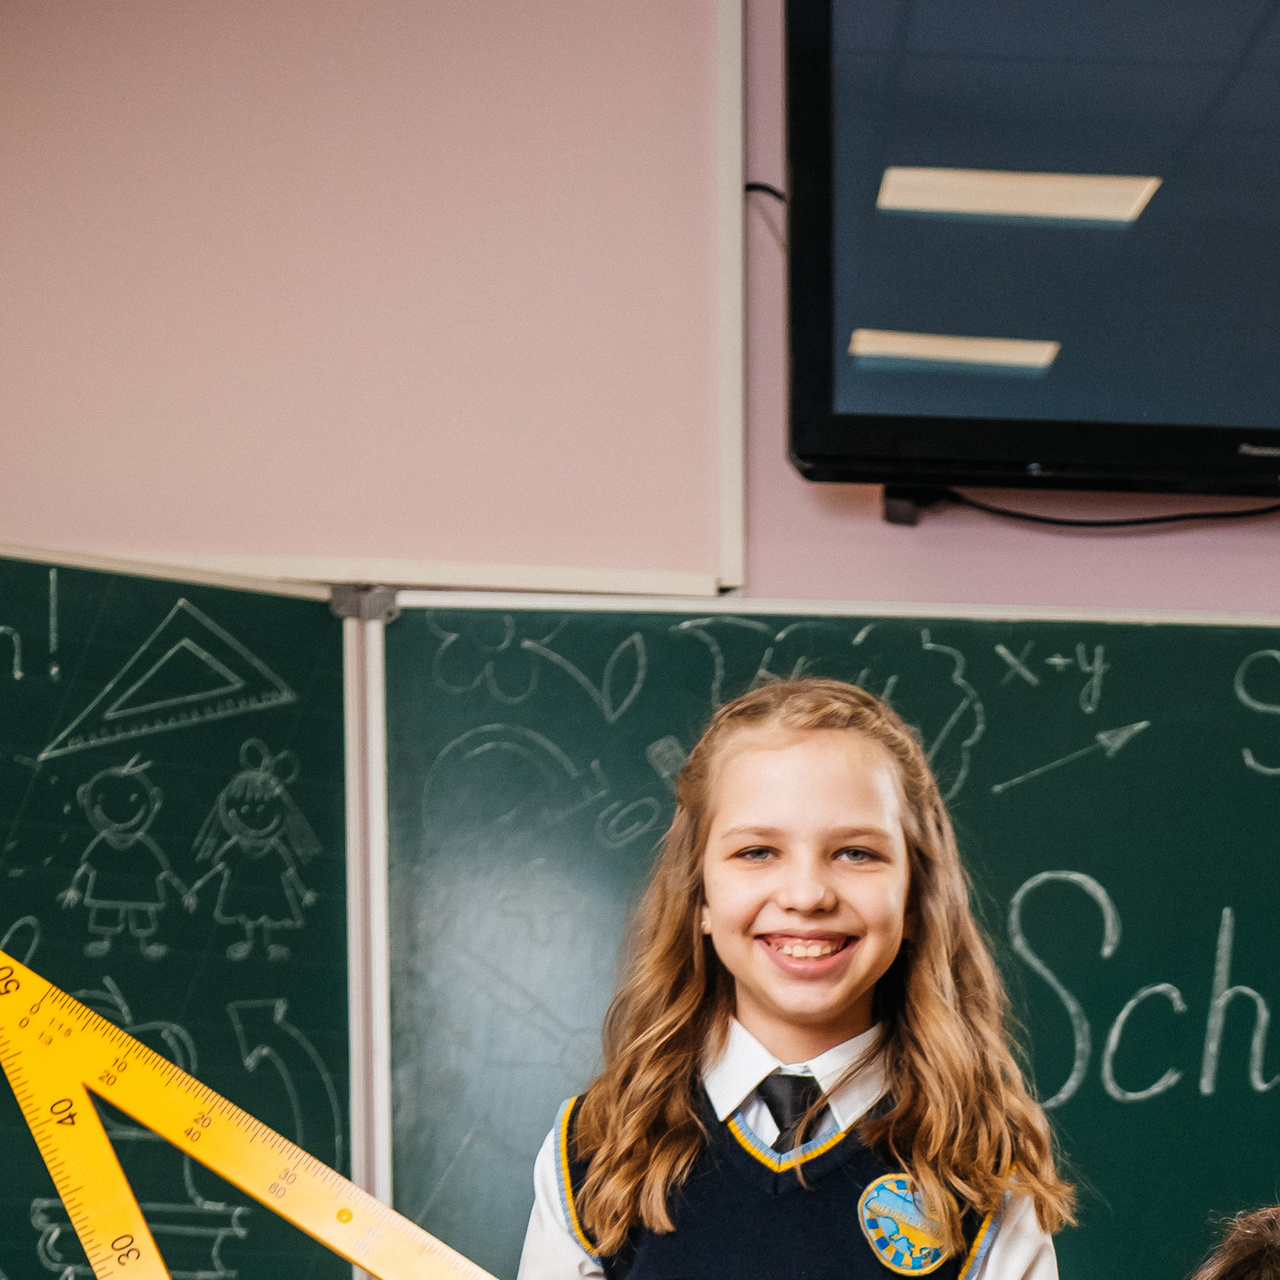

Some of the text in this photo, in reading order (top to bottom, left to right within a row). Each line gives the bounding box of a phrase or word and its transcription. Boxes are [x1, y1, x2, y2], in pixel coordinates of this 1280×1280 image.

[112, 1056, 128, 1073] 10
[98, 1069, 118, 1087] 20
[50, 1098, 79, 1126] 40
[193, 1111, 213, 1129] 20
[183, 1126, 202, 1143] 40
[278, 1167, 297, 1186] 30
[111, 1234, 142, 1266] 30
